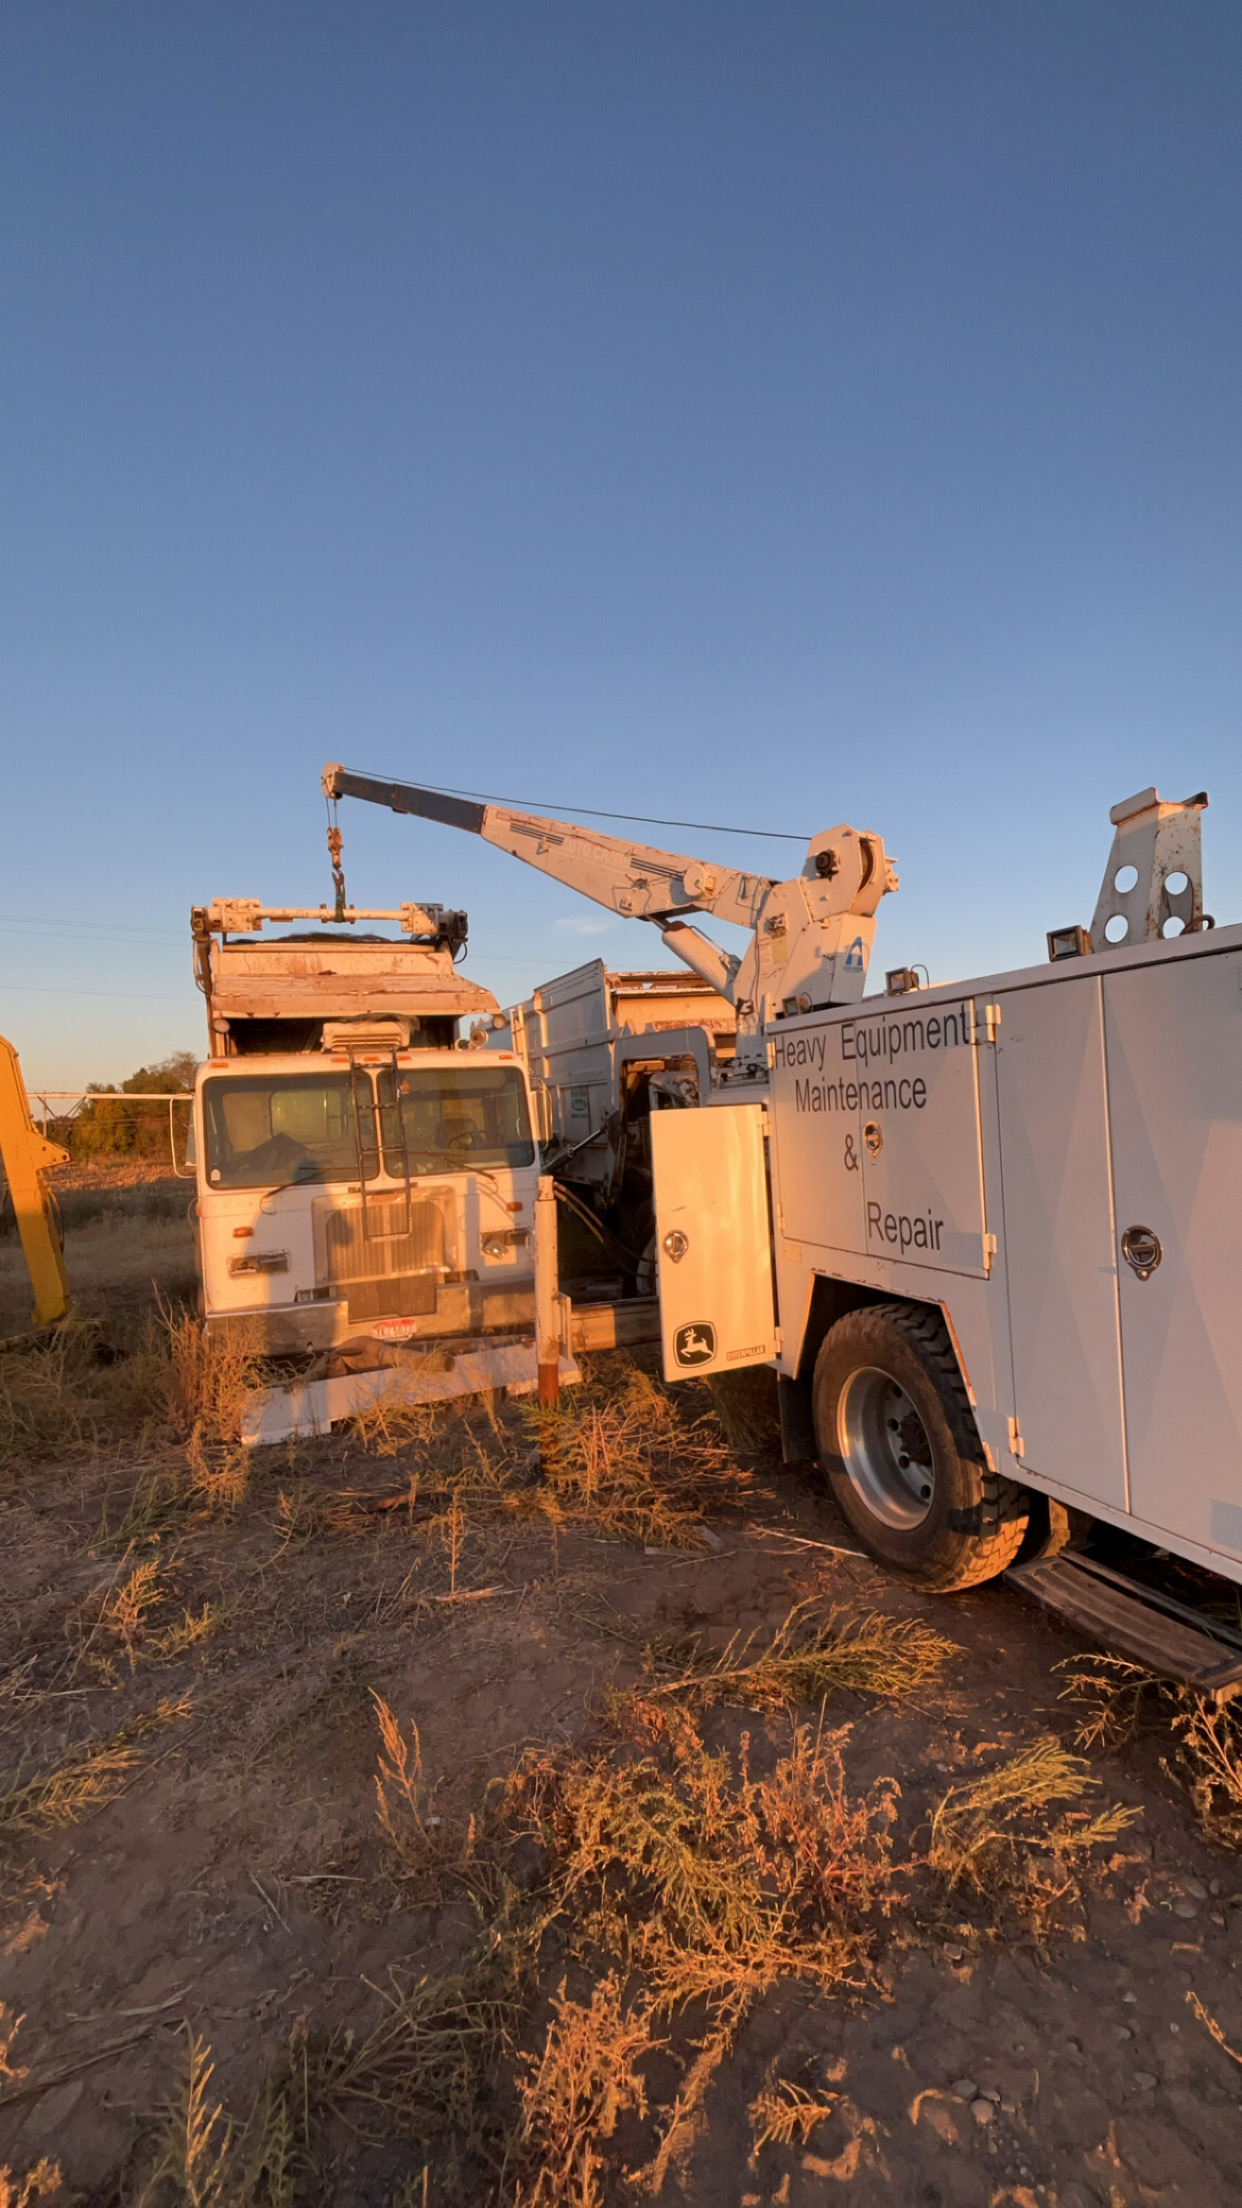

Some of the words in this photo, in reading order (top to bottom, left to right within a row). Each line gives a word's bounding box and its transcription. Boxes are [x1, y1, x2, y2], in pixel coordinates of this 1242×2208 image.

[774, 1034, 827, 1072] Heavy
[841, 1003, 970, 1068] Equipment
[795, 1076, 928, 1113] Maintenance
[844, 1133, 859, 1171] &
[867, 1201, 944, 1256] Repair
